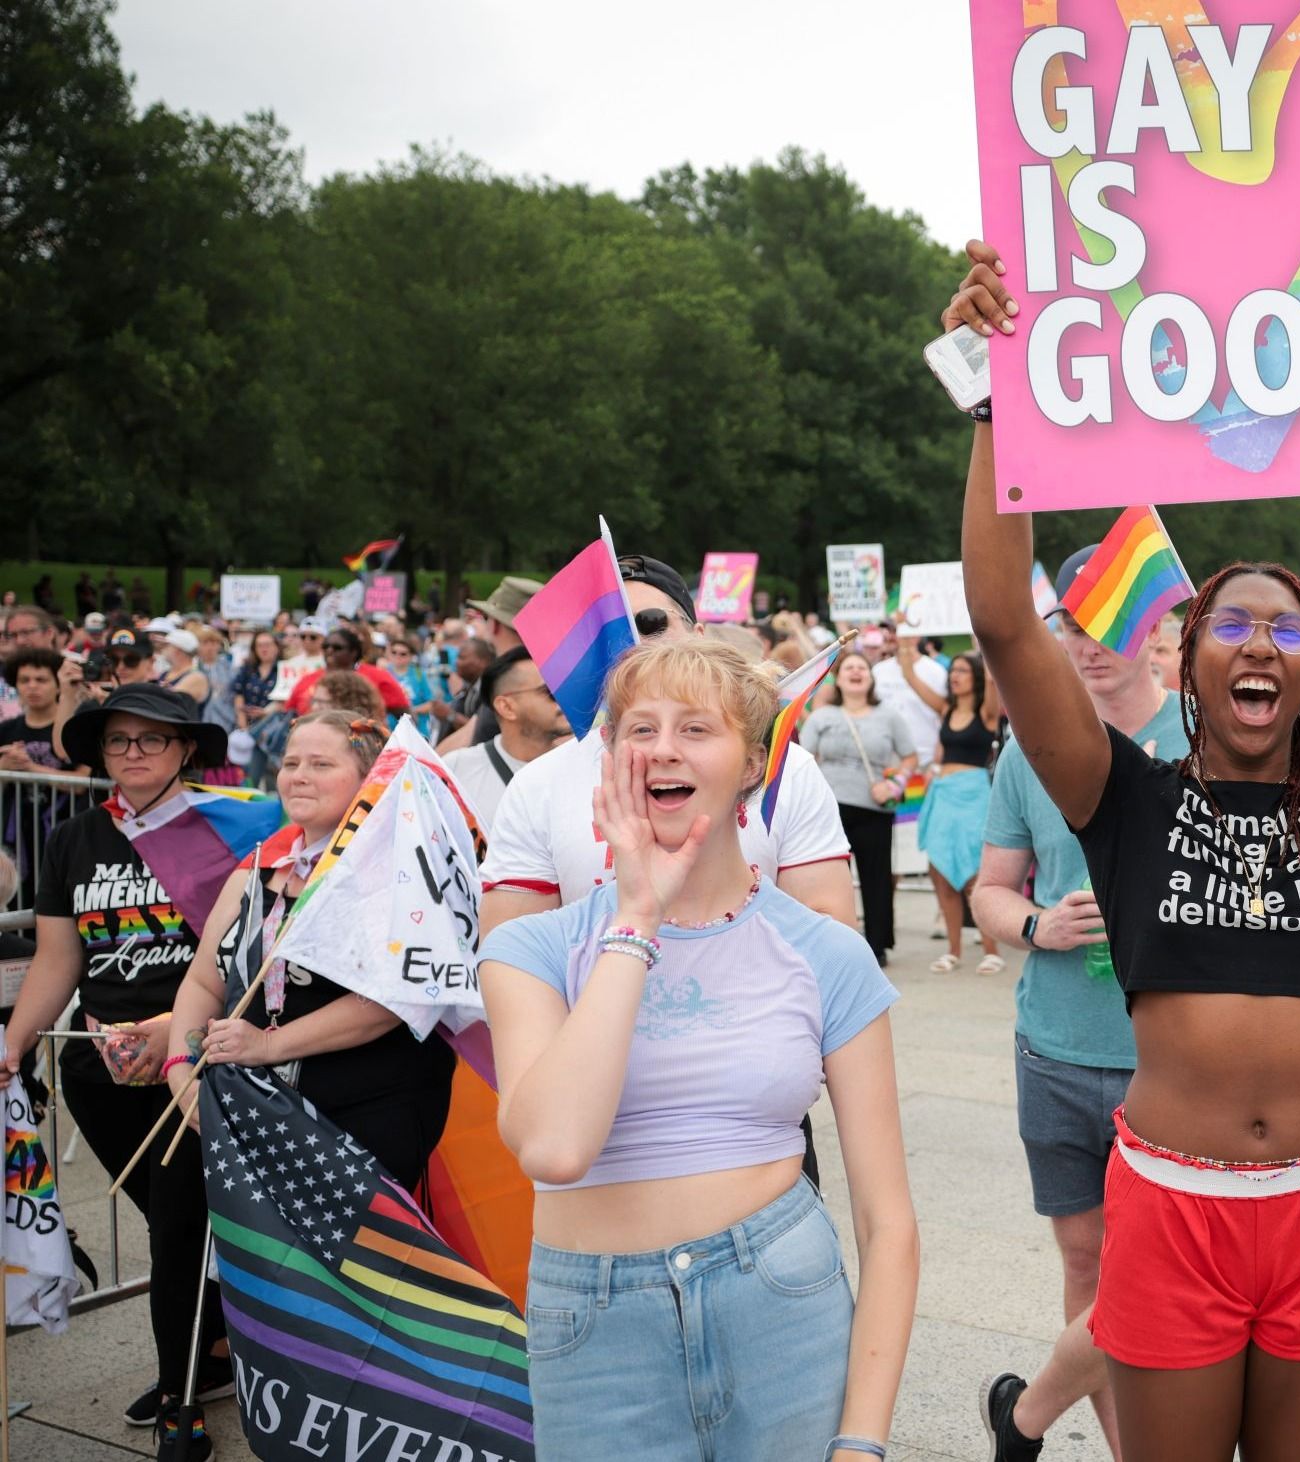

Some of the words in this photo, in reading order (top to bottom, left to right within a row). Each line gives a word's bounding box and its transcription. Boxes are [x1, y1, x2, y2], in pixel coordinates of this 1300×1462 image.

[1011, 23, 1274, 158] GAY
[1020, 160, 1147, 294] IS
[73, 878, 171, 914] AMERIC
[1168, 869, 1192, 893] a
[1204, 873, 1285, 916] litte
[77, 904, 184, 948] GAY
[88, 931, 195, 981] Again
